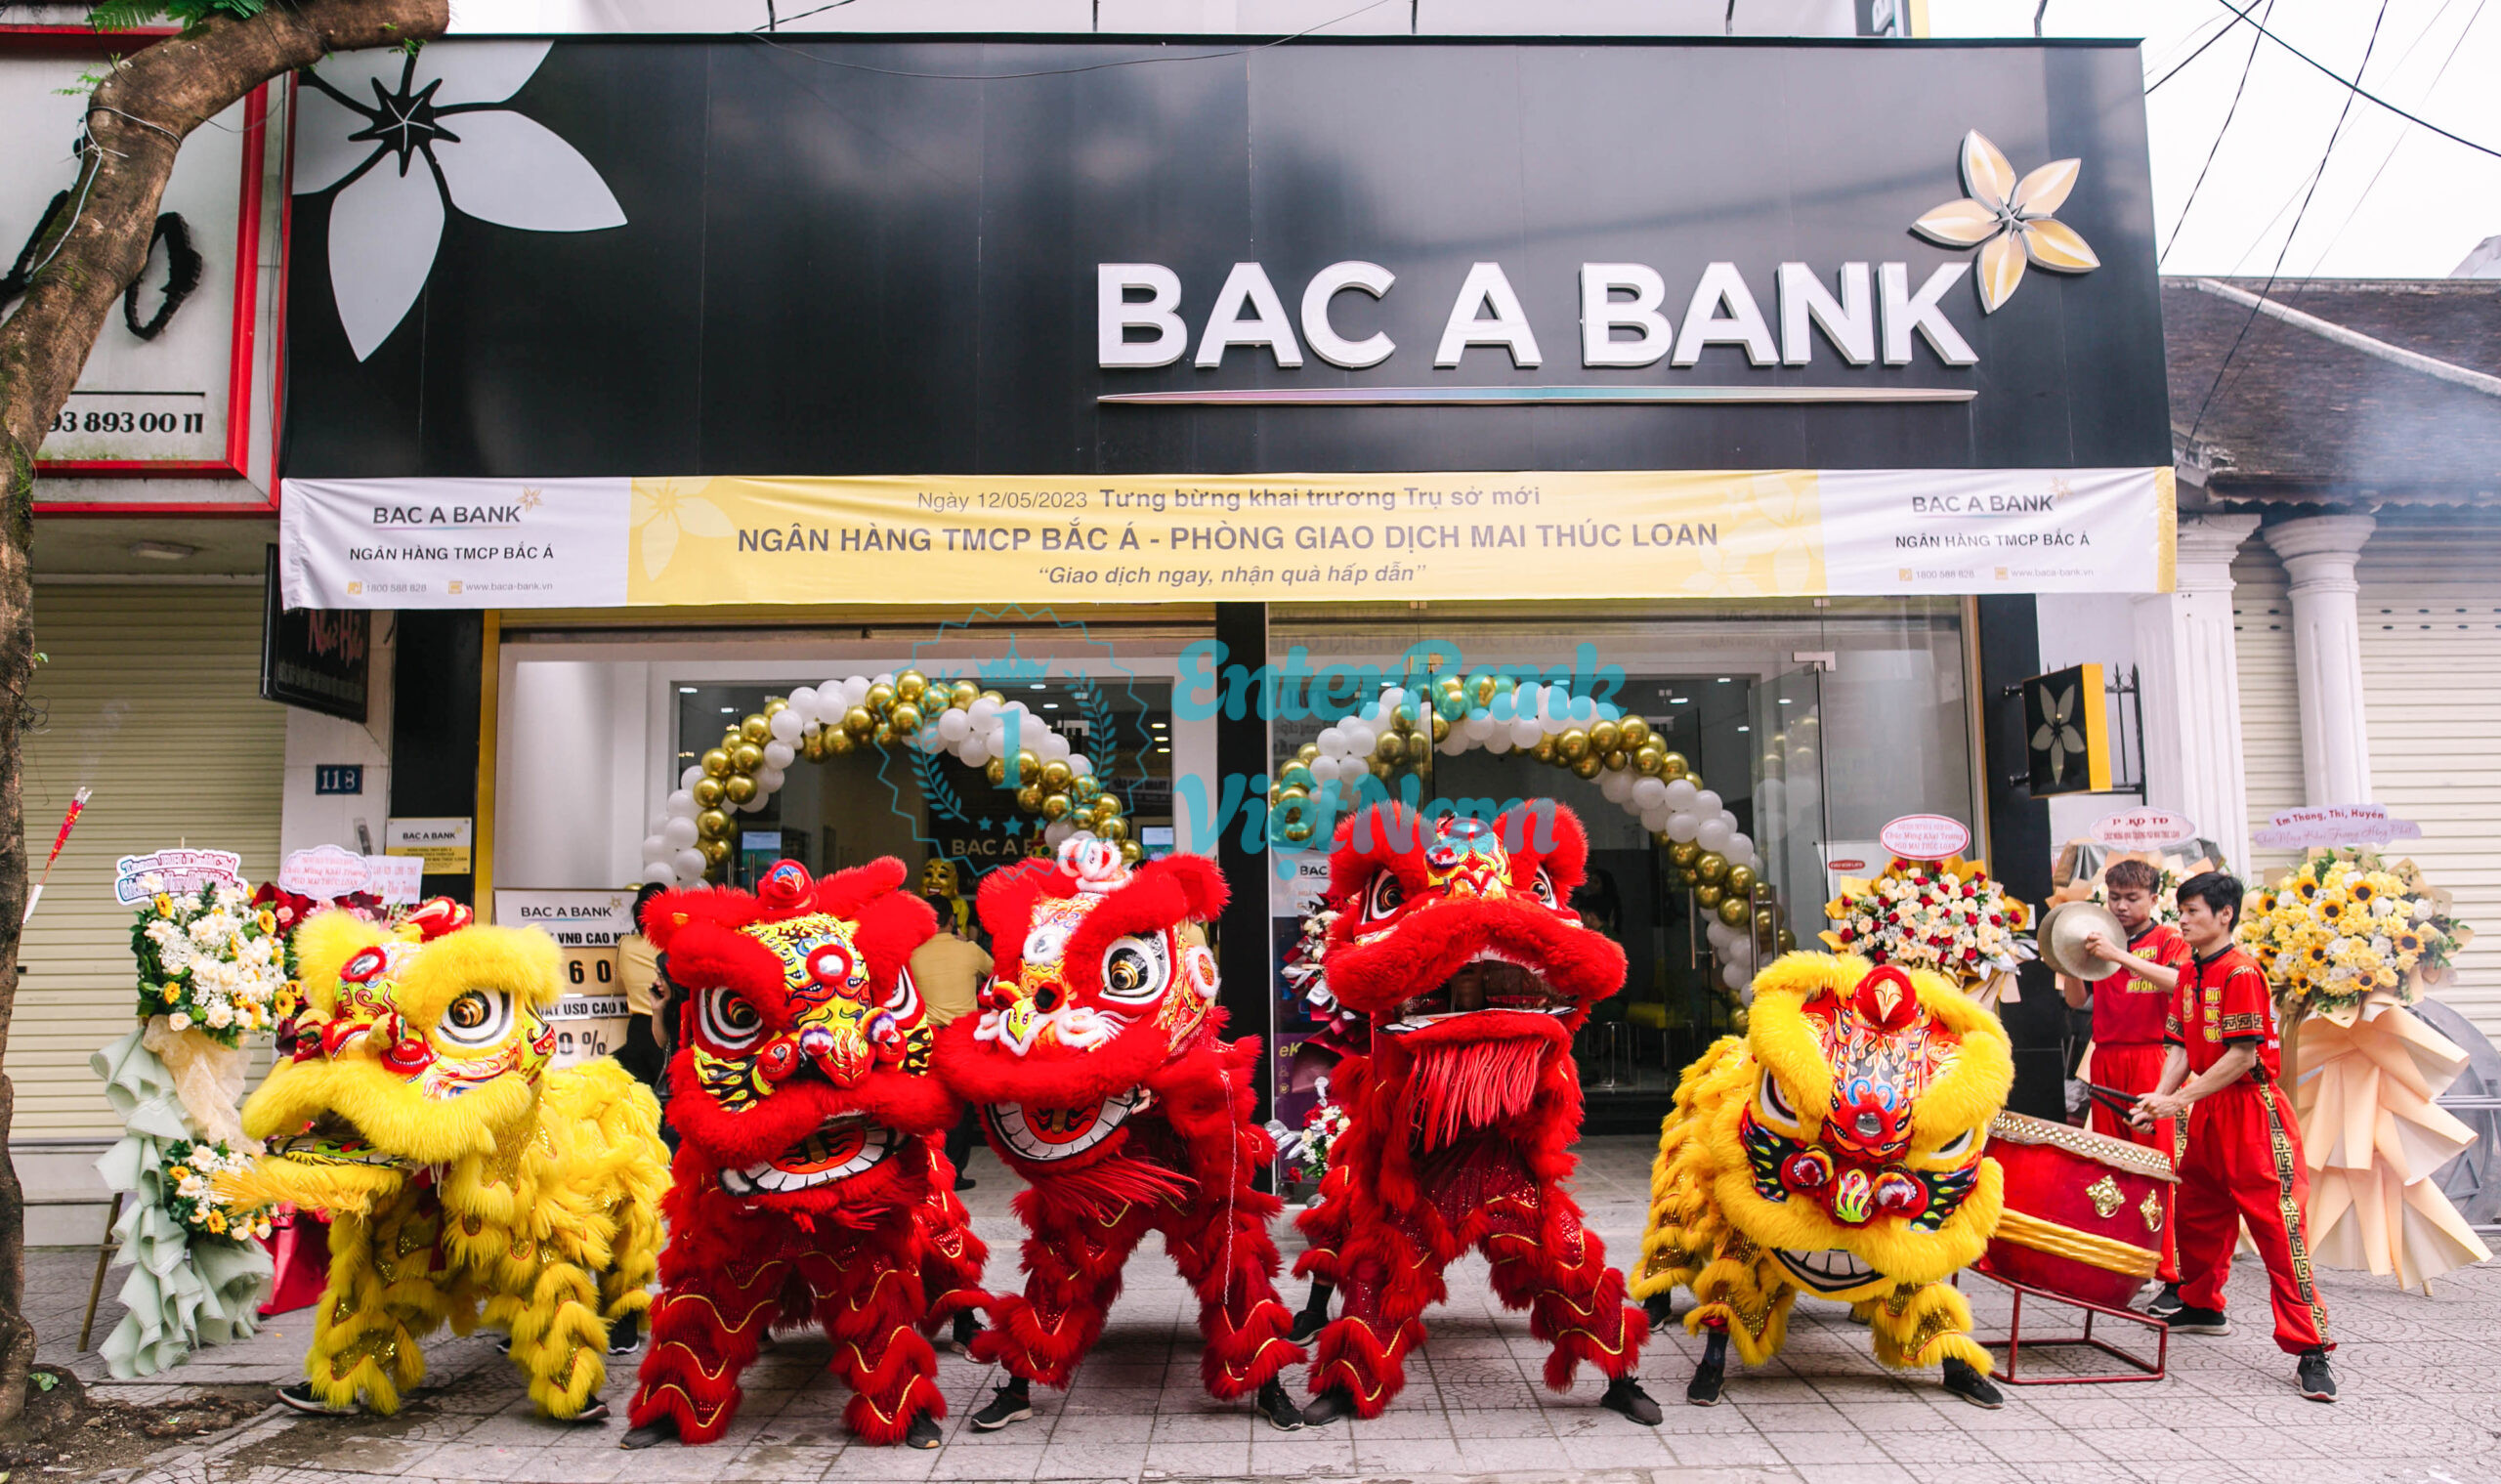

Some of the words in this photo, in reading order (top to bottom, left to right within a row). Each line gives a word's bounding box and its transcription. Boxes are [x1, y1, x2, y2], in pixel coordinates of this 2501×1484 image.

[1098, 261, 1396, 368] BAC
[1433, 262, 1543, 368] A
[1581, 261, 1979, 368] BANK
[83, 411, 134, 433] 893
[140, 412, 177, 433] 00
[184, 412, 203, 434] 11
[917, 490, 969, 511] Ngày
[977, 493, 1087, 509] 12/05/2023
[1099, 489, 1166, 511] Tưng
[1175, 488, 1240, 510] bừng
[1250, 488, 1298, 506] khai
[1306, 488, 1396, 510] trương
[1404, 488, 1442, 510] Trụ
[1452, 487, 1483, 505] sở
[1492, 488, 1541, 504] mới
[1913, 496, 1961, 513] BAC
[1968, 496, 1984, 512] A
[1990, 495, 2054, 512] BANK
[373, 506, 422, 524] BAC
[430, 506, 446, 524] A
[453, 505, 521, 523] BANK
[738, 523, 829, 552] NGÂN
[841, 523, 931, 551] HÀNG
[943, 528, 1031, 551] TMCP
[1041, 517, 1108, 550] BẮC
[1120, 521, 1140, 550] Á
[1171, 521, 1284, 550] PHÒNG
[1295, 525, 1374, 549] GIAO
[1385, 524, 1460, 554] DỊCH
[1471, 524, 1526, 548] MAI
[1536, 518, 1621, 548] THÚC
[1632, 522, 1717, 547] LOAN
[1896, 532, 1940, 548] NGÂN
[1945, 530, 1991, 548] HÀNG
[1999, 534, 2038, 547] TMCP
[2043, 528, 2075, 546] BẮC
[2080, 530, 2090, 546] Á
[350, 545, 397, 561] NGÂN
[403, 544, 448, 561] HÀNG
[453, 547, 498, 560] TMCP
[504, 540, 537, 559] BẮC
[542, 543, 554, 559] Á
[1106, 565, 1150, 585] dịch
[1157, 570, 1213, 587] ngay,
[1221, 565, 1274, 586] nhận
[1282, 565, 1318, 583] quà
[1327, 562, 1368, 584] hấp
[320, 770, 356, 789] 118
[952, 839, 996, 856] BAC
[1002, 839, 1018, 856] A
[1299, 866, 1328, 876] BAC
[521, 907, 553, 917] BAC
[558, 907, 568, 917] A
[572, 907, 613, 917] BANK
[558, 932, 582, 944] VNĐ
[586, 932, 610, 944] CAO
[564, 1003, 588, 1015] USD
